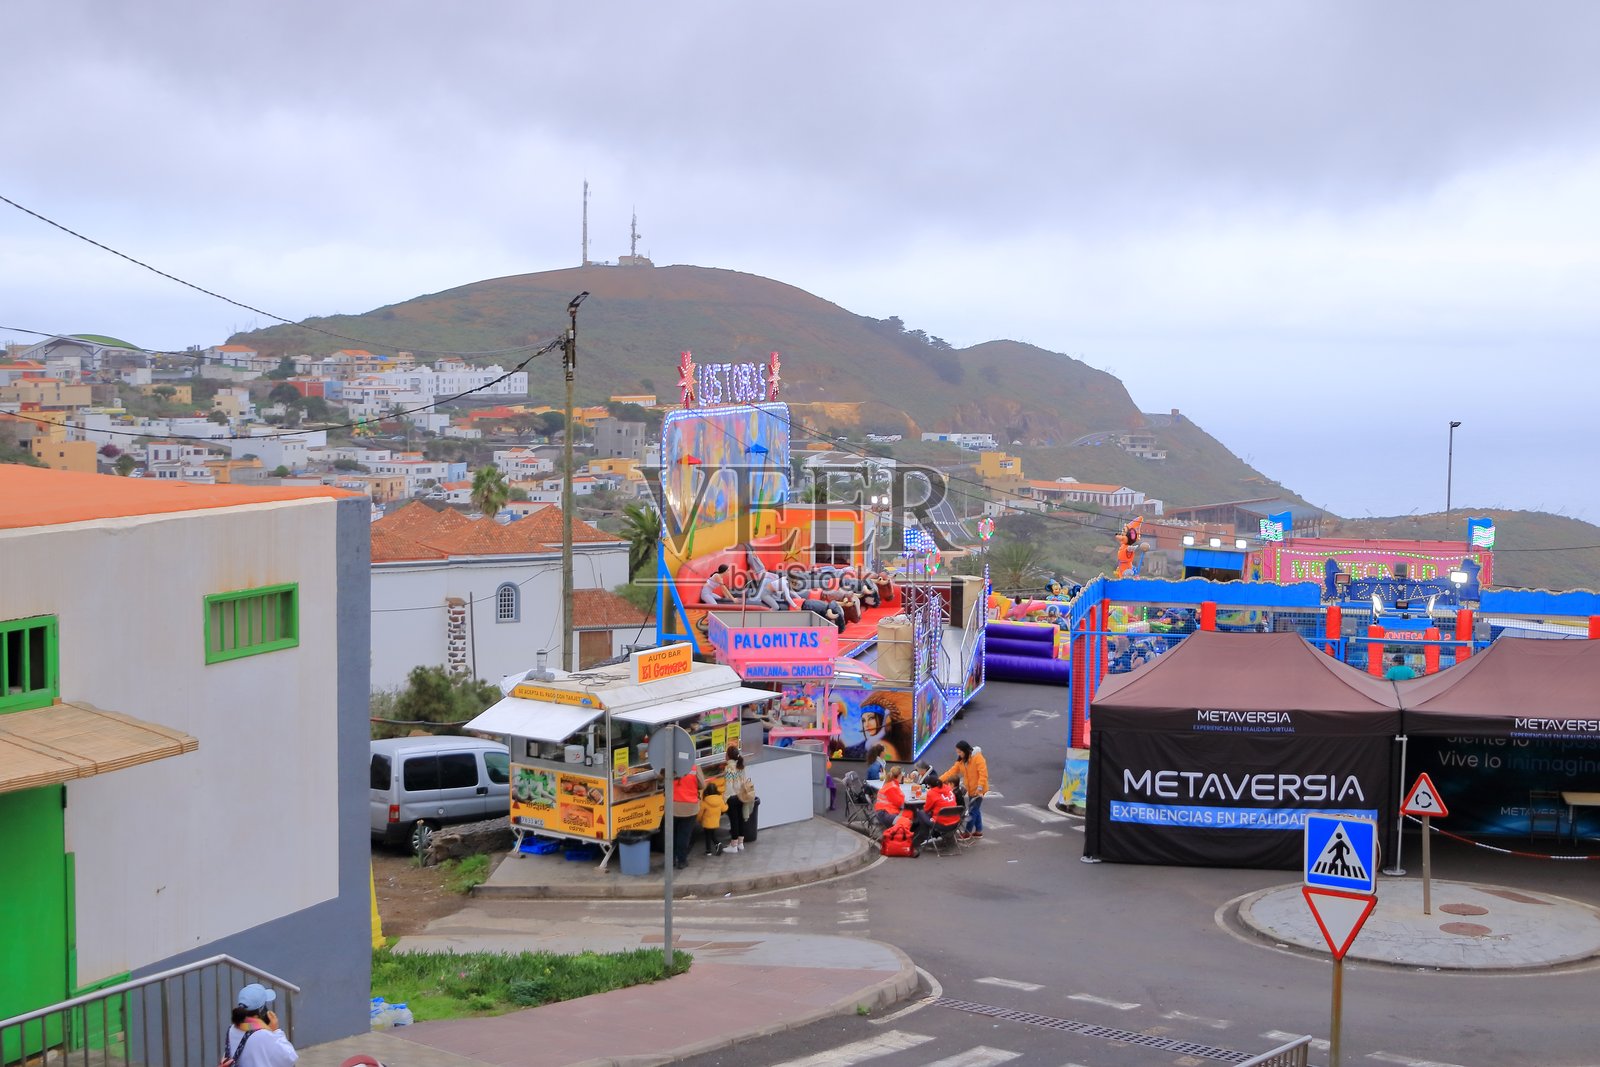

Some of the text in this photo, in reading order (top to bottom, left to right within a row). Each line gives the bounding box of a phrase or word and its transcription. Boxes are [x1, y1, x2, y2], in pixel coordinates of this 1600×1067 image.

[1291, 561, 1438, 582] MOTECALO
[734, 632, 819, 649] PALOMITAS
[648, 649, 681, 662] AUTO BAR
[746, 666, 783, 677] MANZANA
[792, 665, 833, 677] CARAMELO
[1197, 710, 1291, 723] METAVERSIA
[1438, 750, 1479, 768] Vive
[1484, 752, 1502, 769] lo
[1123, 768, 1365, 801] METAVERSIA
[1112, 805, 1213, 824] EXPERIENCIAS
[1216, 811, 1236, 825] EN
